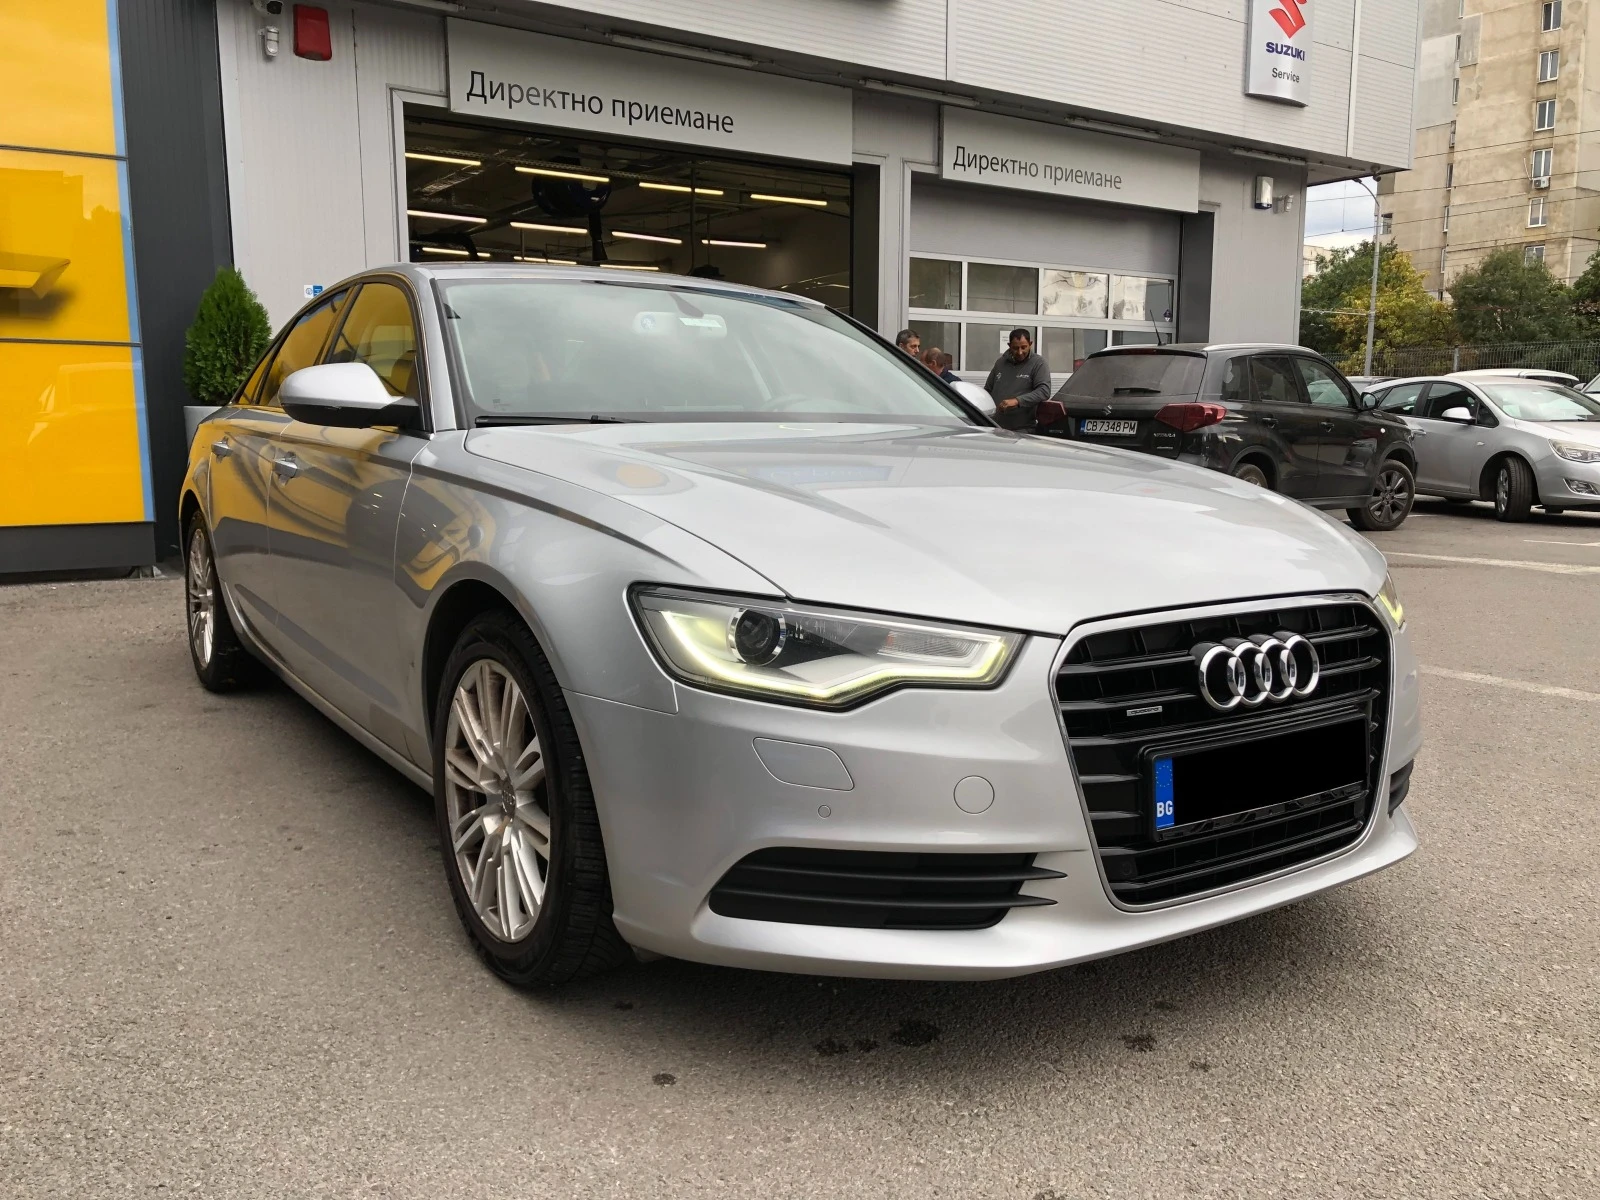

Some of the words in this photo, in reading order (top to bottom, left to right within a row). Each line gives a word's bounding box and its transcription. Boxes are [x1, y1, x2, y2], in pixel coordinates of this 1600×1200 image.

[1266, 42, 1305, 61] SUZUKI
[1272, 67, 1300, 83] Service
[466, 70, 603, 114] Директно
[612, 98, 734, 134] приемане
[953, 145, 1039, 177] Директно
[1043, 164, 1122, 189] приемане
[1156, 800, 1173, 817] BG
